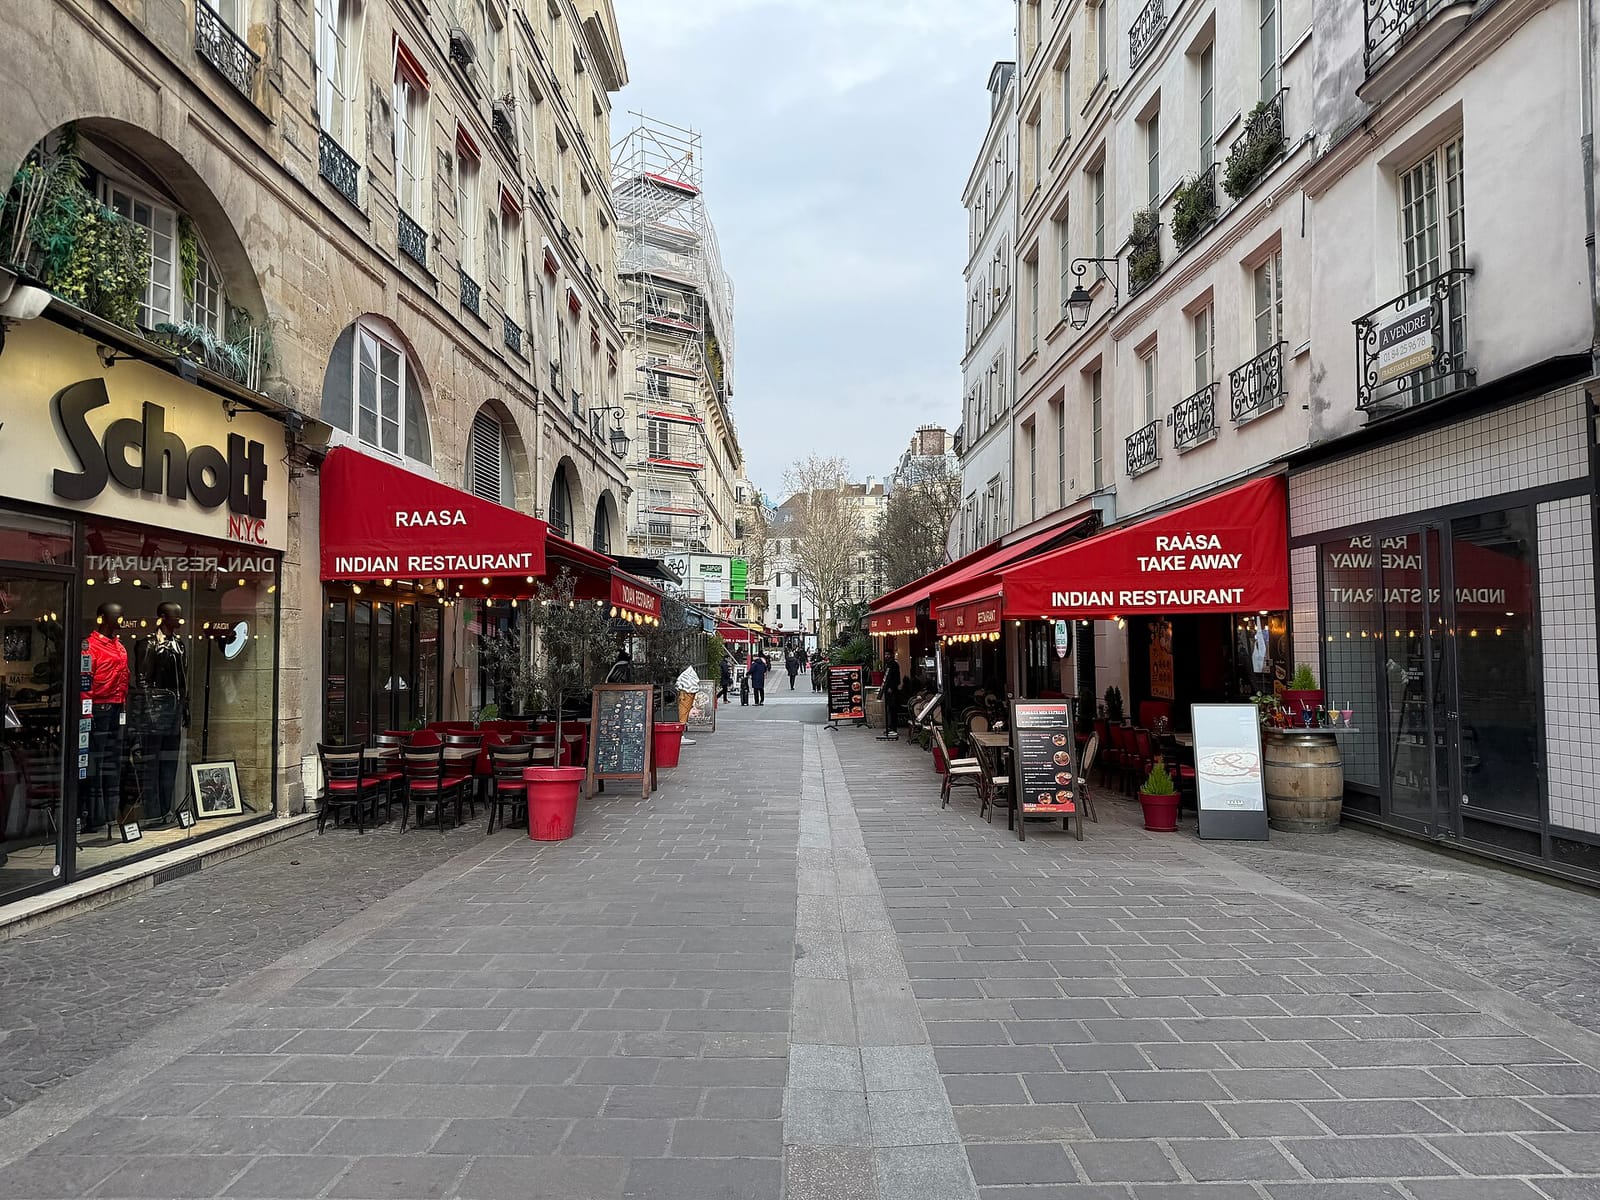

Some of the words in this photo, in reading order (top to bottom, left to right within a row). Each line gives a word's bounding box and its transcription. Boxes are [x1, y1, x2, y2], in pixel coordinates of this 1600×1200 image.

[1390, 314, 1426, 341] VENDRE
[50, 377, 267, 519] Schott
[395, 510, 466, 527] RAASA
[228, 514, 268, 545] N.Y.C.
[335, 556, 398, 573] INDIAN
[408, 553, 532, 571] RESTAURANT
[1137, 556, 1186, 571] TAKE
[1189, 554, 1242, 570] AWAY
[1052, 591, 1113, 607] INDIAN
[1119, 588, 1244, 606] RESTAURANT
